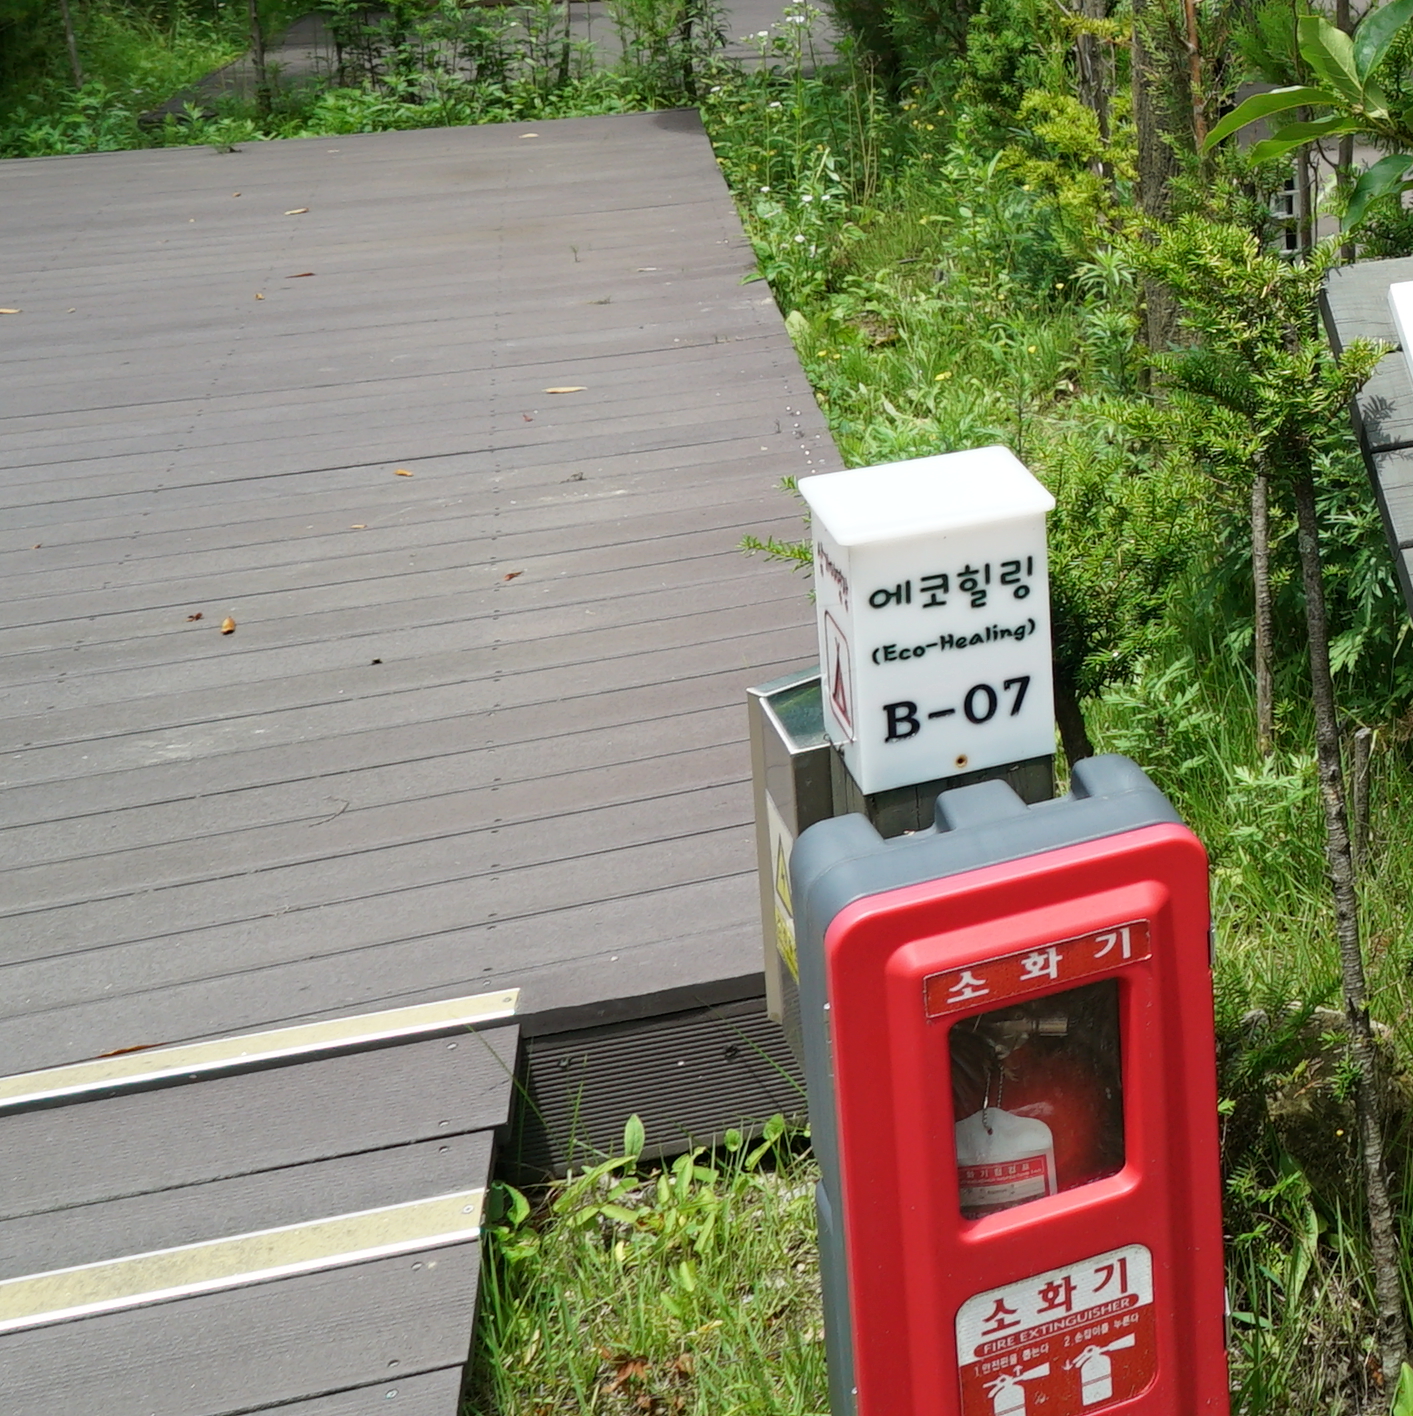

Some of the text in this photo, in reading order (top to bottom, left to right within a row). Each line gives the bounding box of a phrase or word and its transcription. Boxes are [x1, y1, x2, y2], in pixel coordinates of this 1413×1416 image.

[868, 556, 1034, 610] 에코힐링
[872, 618, 1037, 666] (Eco-Healing)
[882, 676, 1032, 743] B-07
[981, 1257, 1128, 1337] 소화기
[984, 1298, 1130, 1354] FIRE EXTINGUISHER
